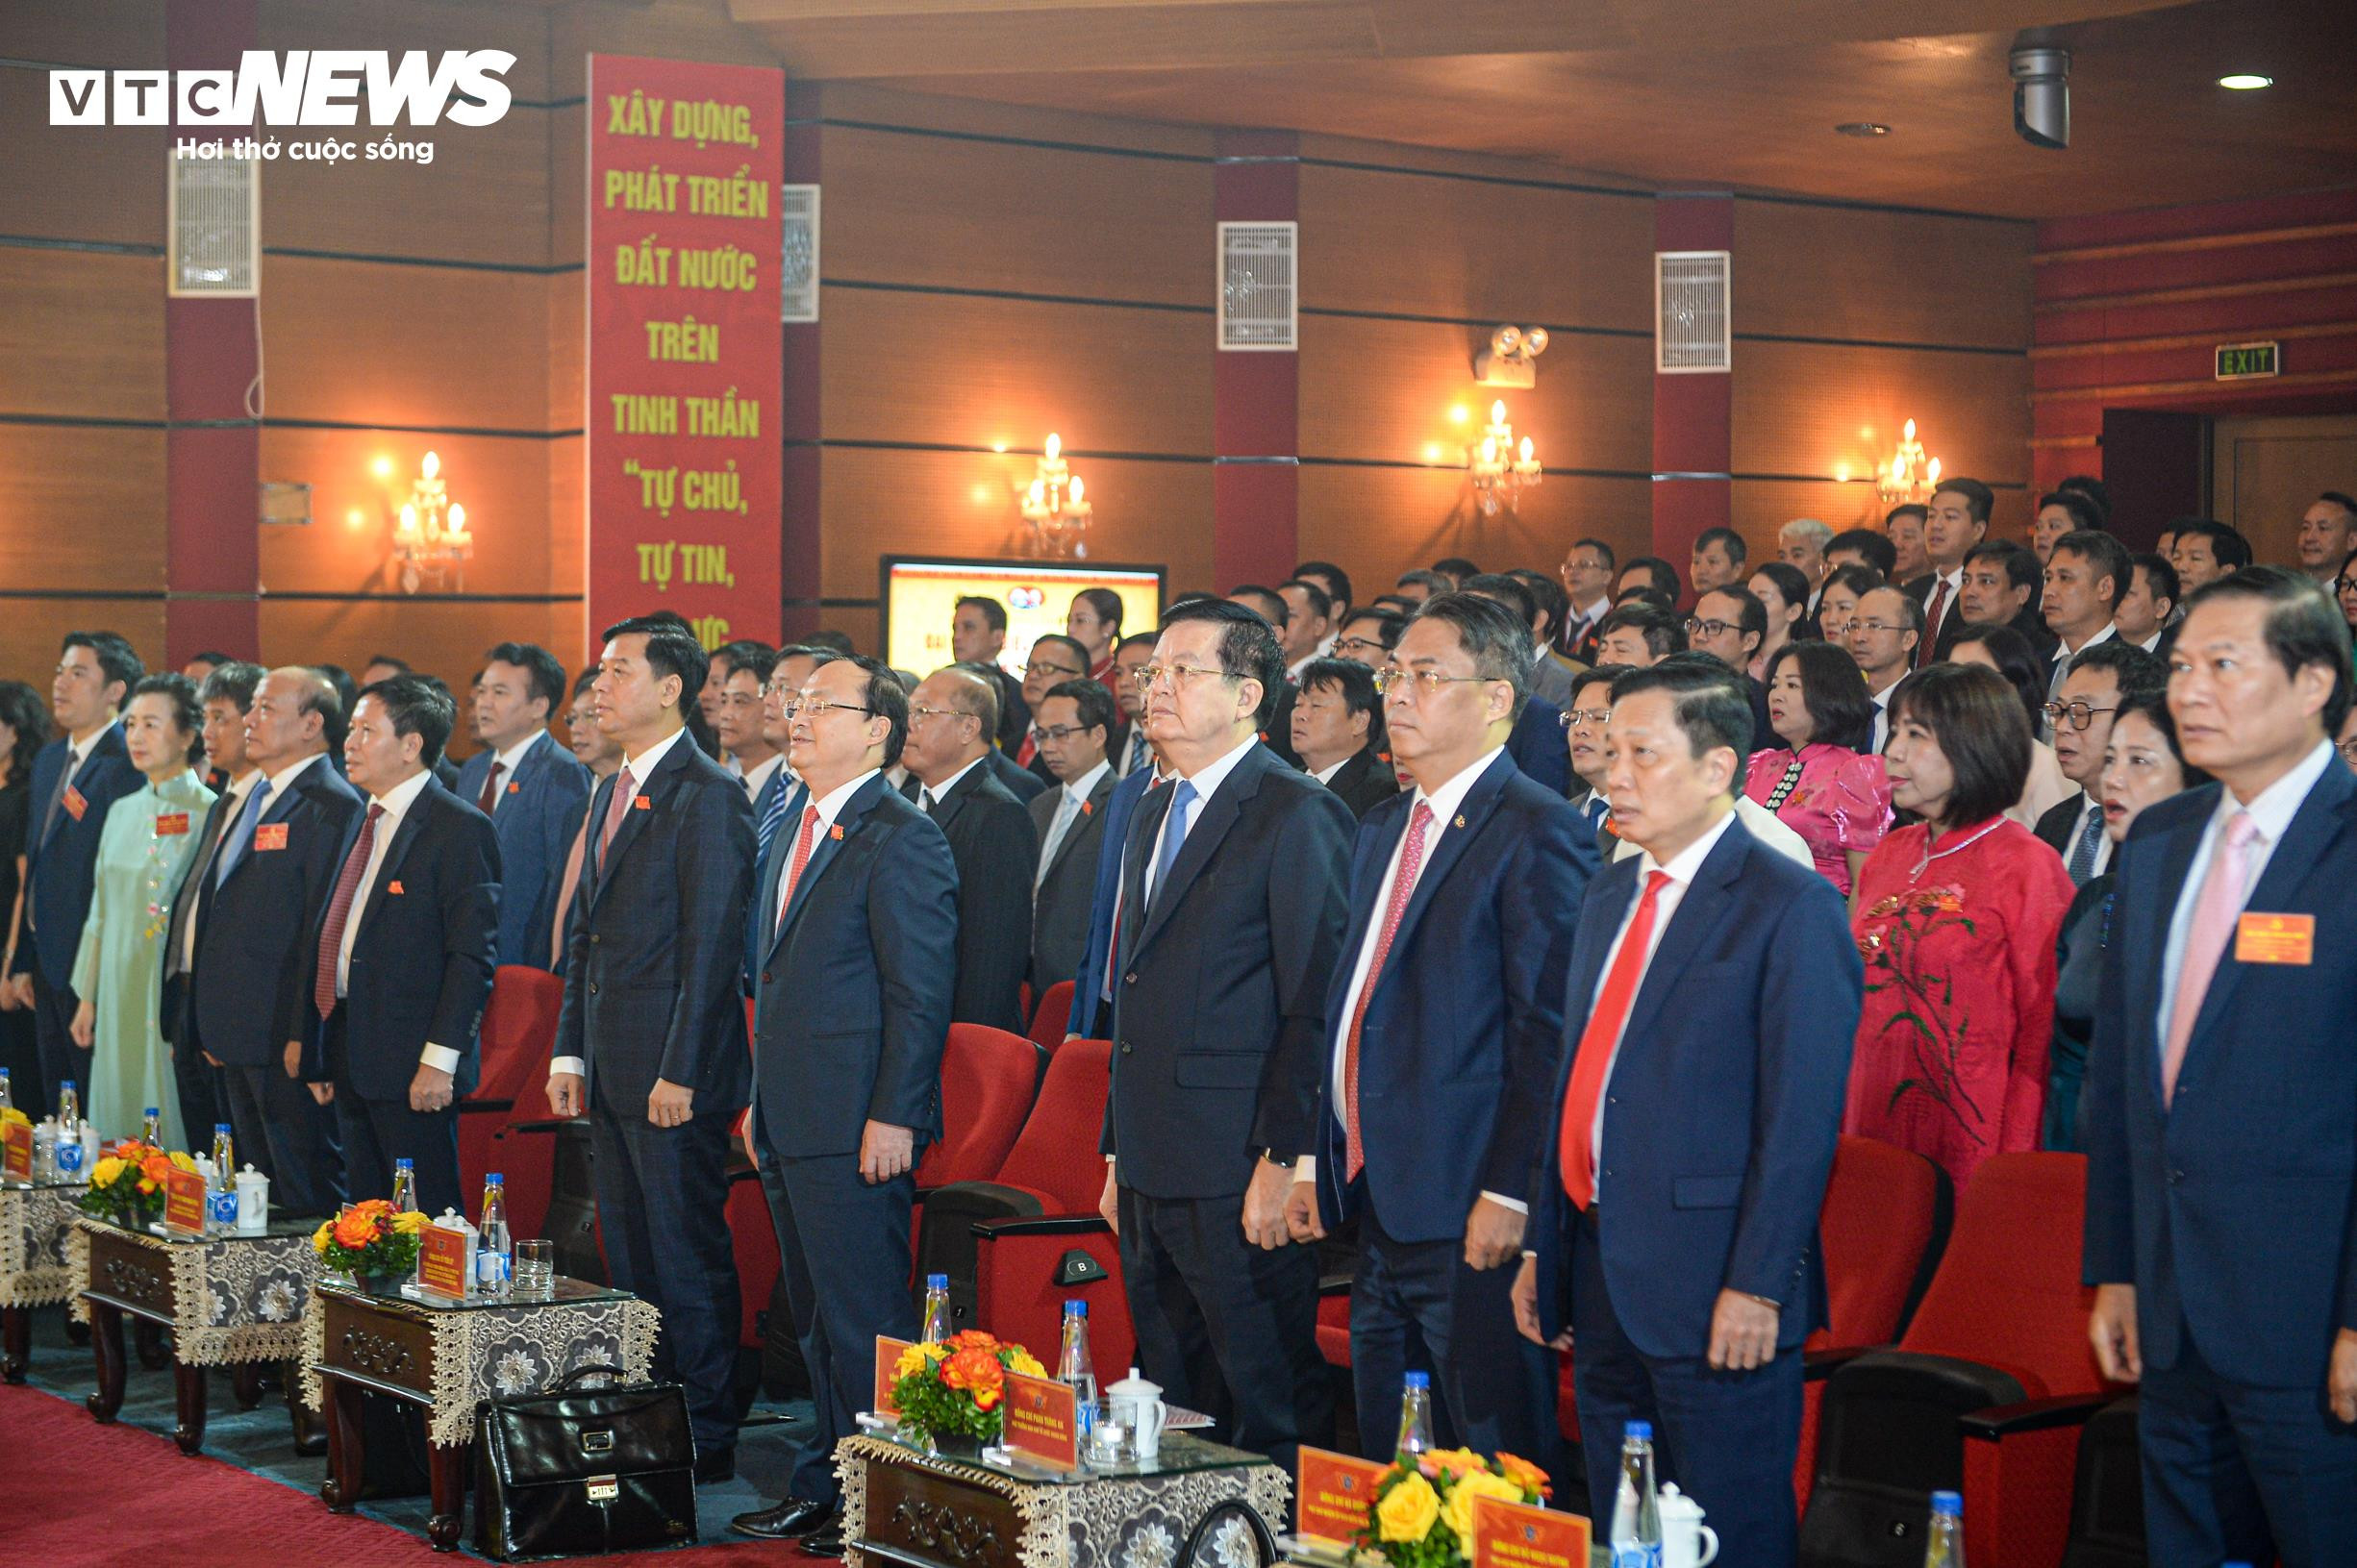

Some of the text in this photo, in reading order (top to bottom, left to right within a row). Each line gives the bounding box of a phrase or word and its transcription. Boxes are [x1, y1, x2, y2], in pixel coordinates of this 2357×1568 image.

[608, 89, 759, 149] XÂY DỰNG,
[605, 163, 768, 218] PHÁT TRIỂN
[616, 234, 757, 291] ĐẤT NƯỚC
[645, 314, 719, 363] TRÊN
[2224, 347, 2268, 374] EXIT
[611, 386, 760, 438] TINH THẦN
[683, 460, 748, 516] CHỦ,
[637, 541, 735, 591] TỰ TIN,
[1078, 1262, 1087, 1271] B
